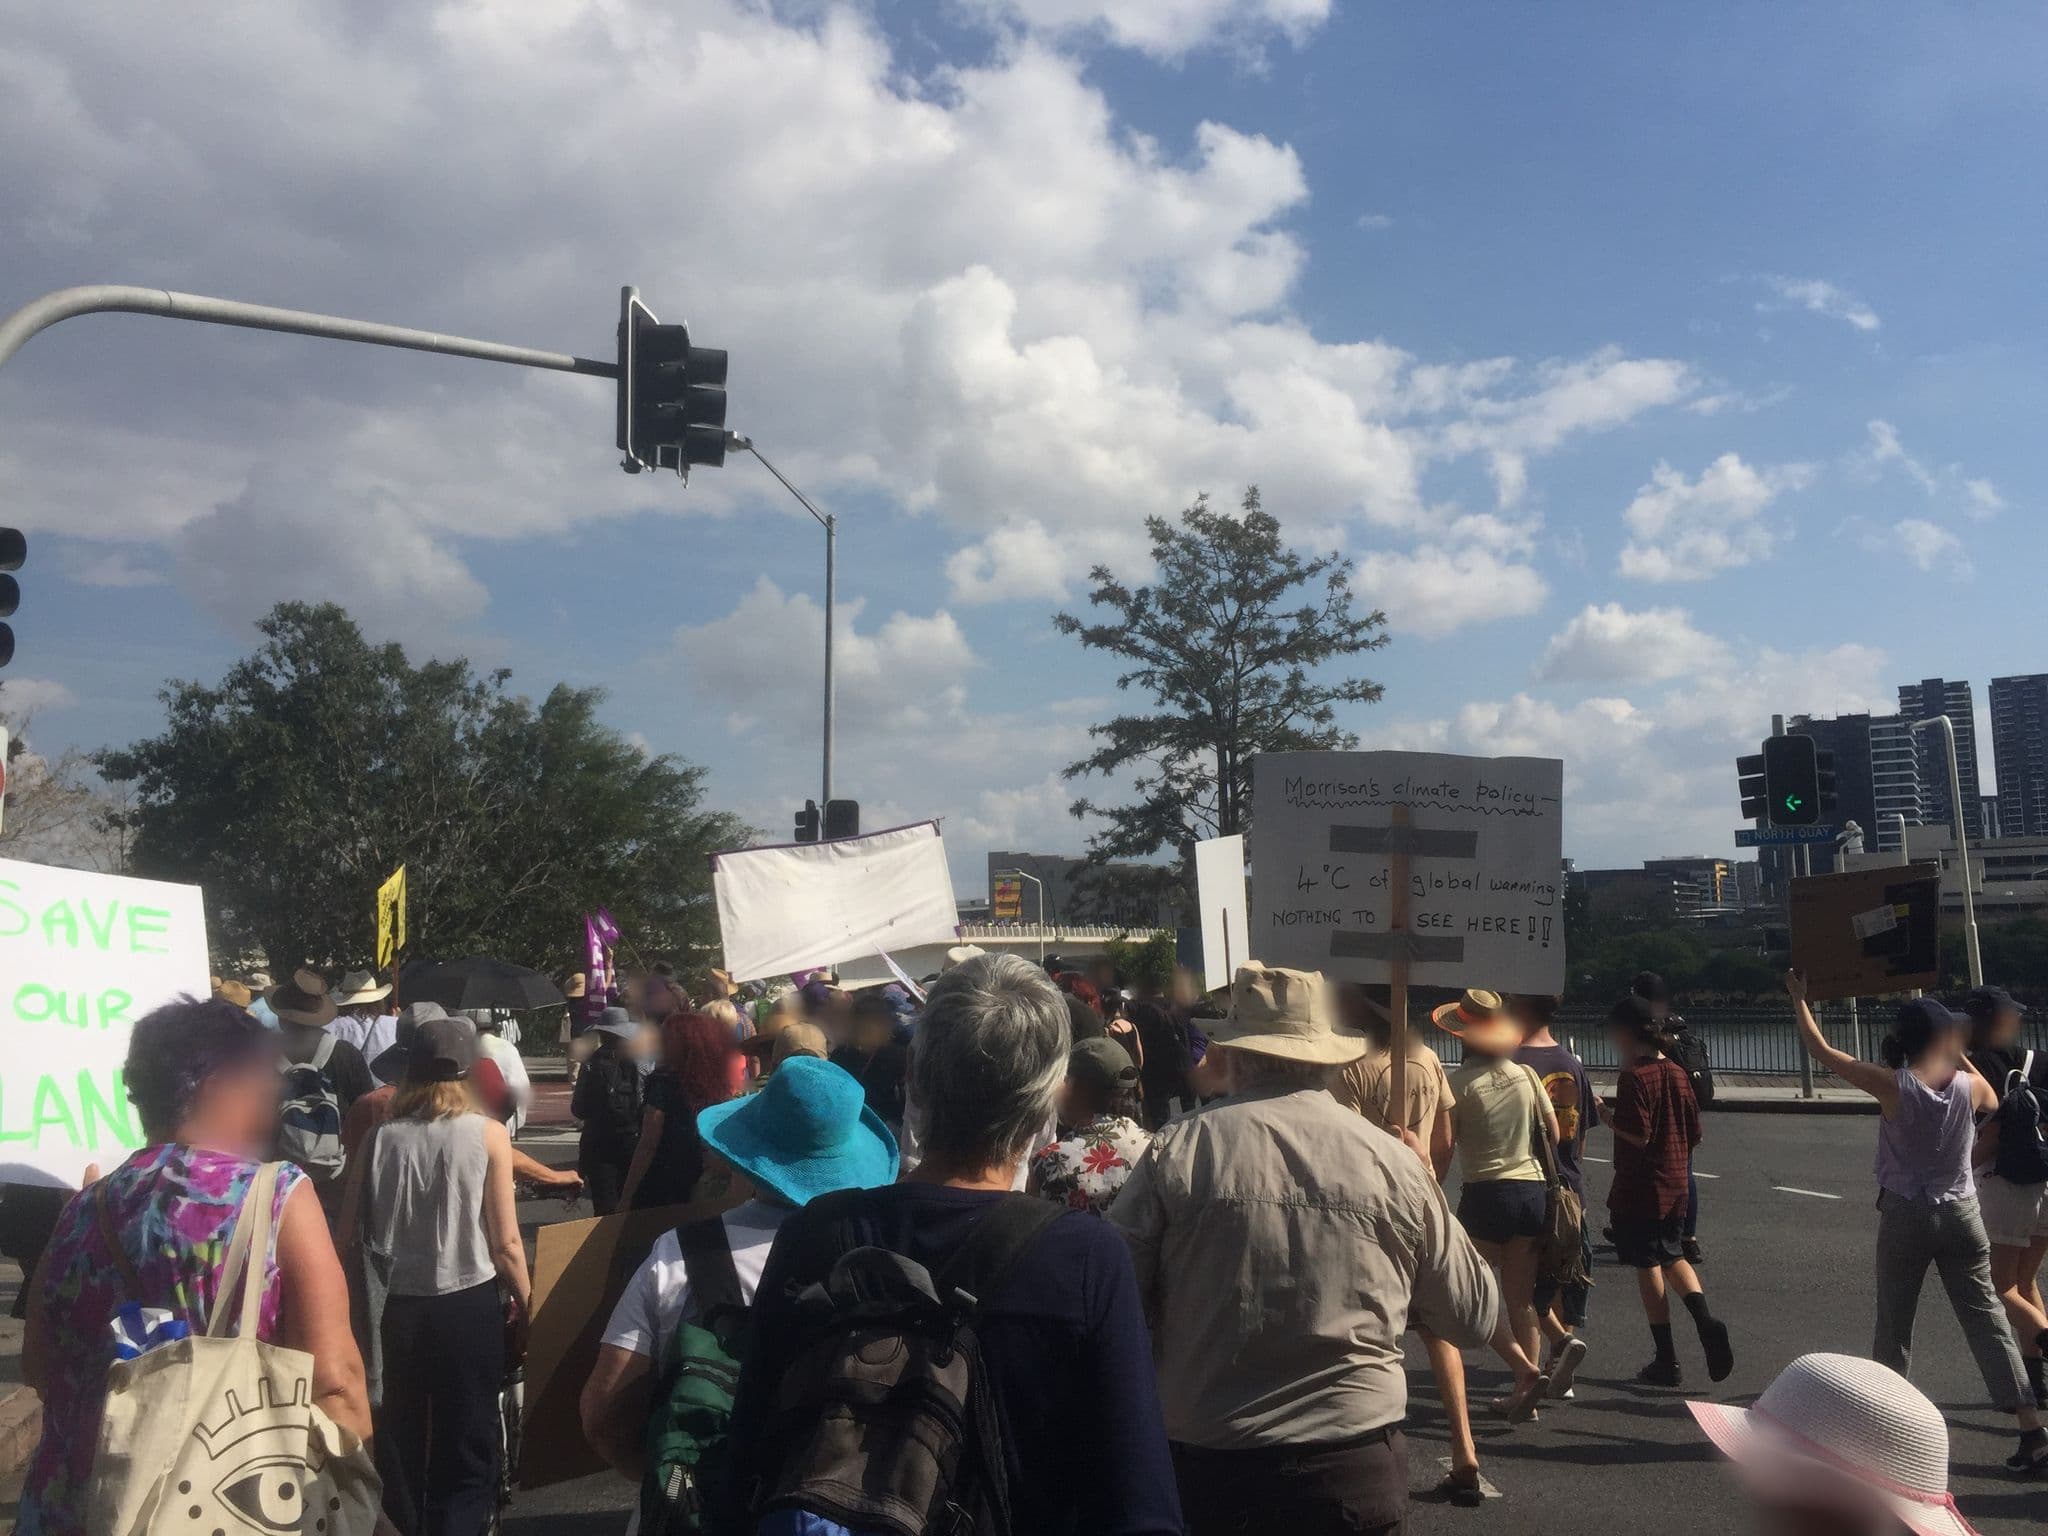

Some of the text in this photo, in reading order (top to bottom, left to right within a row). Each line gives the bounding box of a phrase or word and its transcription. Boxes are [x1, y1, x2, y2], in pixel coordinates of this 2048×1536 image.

[1285, 776, 1380, 800] Morrison's
[1393, 776, 1459, 799] climate
[1754, 828, 1830, 840] NORTH QUAY
[1369, 869, 1389, 890] of
[1412, 872, 1480, 897] global
[1490, 878, 1556, 906] warming
[0, 879, 171, 953] SAVE
[1273, 909, 1341, 927] NOTHING
[1352, 909, 1375, 925] TO
[1416, 912, 1454, 928] SEE
[13, 982, 136, 1030] OUR
[0, 1067, 147, 1152] LAN
